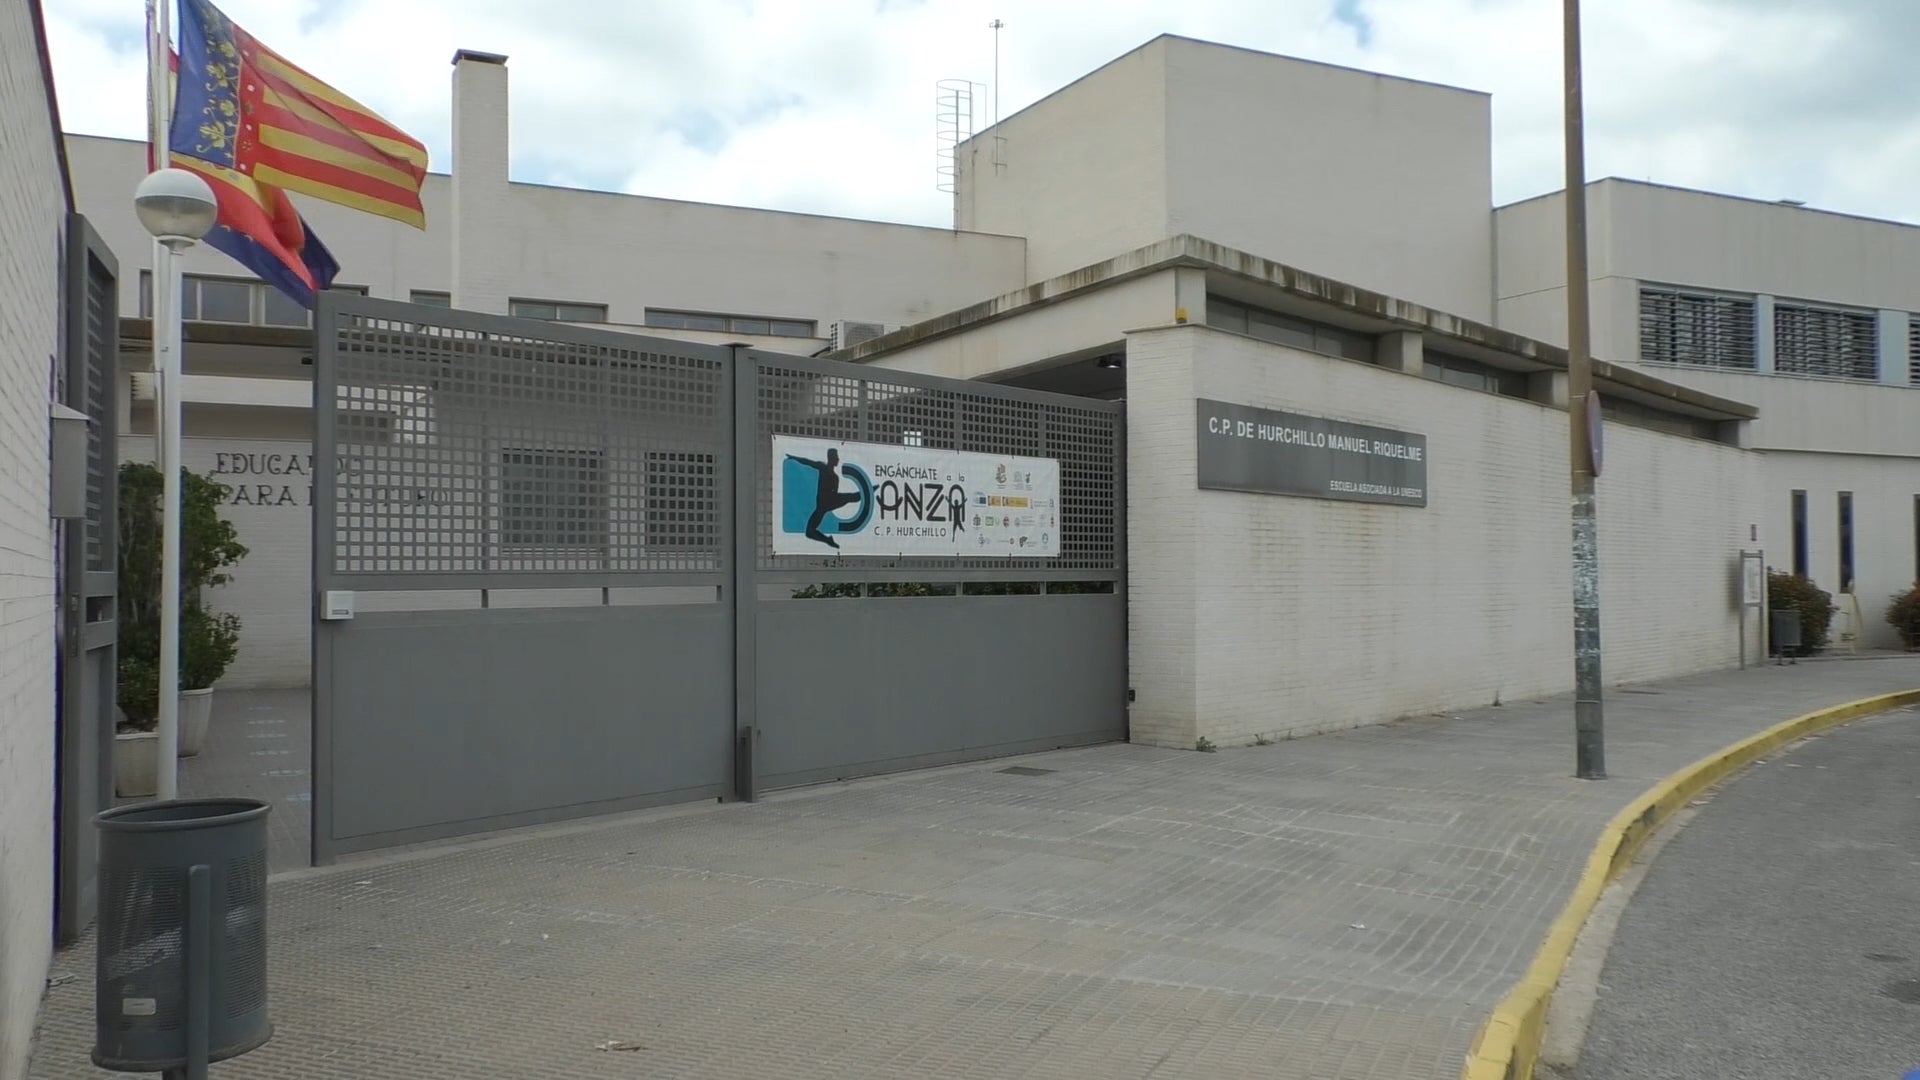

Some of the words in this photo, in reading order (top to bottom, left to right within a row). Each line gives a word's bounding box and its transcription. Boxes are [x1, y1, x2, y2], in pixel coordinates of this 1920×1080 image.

[1209, 416, 1233, 436] C.P.
[1237, 420, 1254, 439] DE
[1257, 424, 1326, 448] HURCHILLO
[1328, 434, 1372, 454] MANUEL
[1374, 441, 1422, 461] RIQUELME
[875, 462, 938, 481] ENGÁNCHATE
[215, 484, 297, 506] PARA
[1330, 480, 1357, 492] ESCUELA
[1358, 483, 1387, 495] ASOCIADA
[1387, 485, 1392, 496] A
[1392, 486, 1400, 496] LA
[1401, 487, 1422, 498] UNESCO
[896, 526, 947, 538] HURCHILLO
